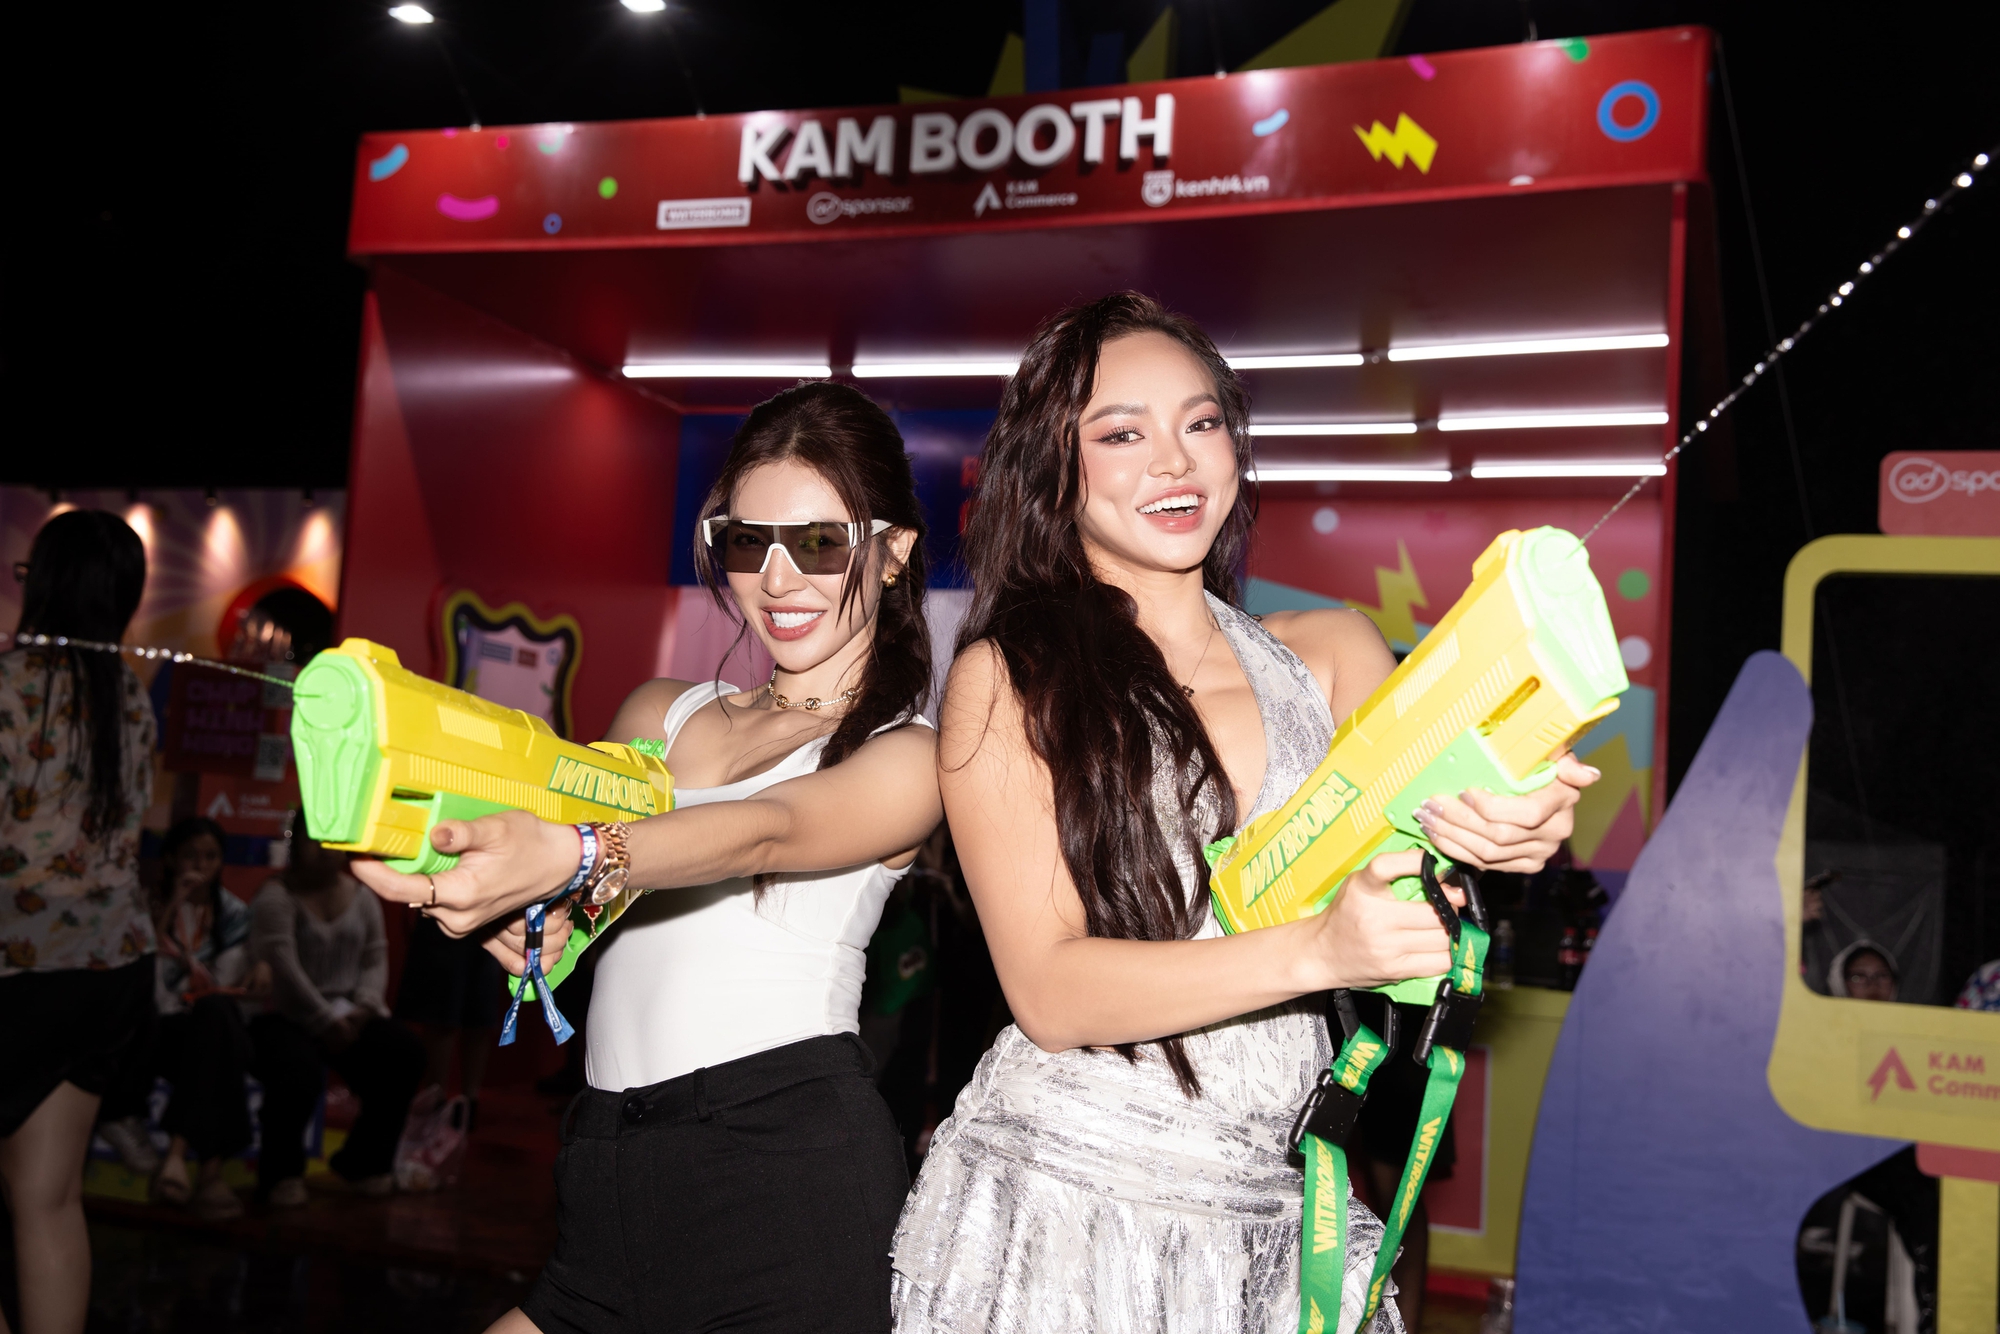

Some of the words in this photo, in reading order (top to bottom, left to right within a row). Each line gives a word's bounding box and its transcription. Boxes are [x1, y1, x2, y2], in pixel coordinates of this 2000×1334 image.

[738, 115, 897, 184] KAM
[909, 93, 1176, 173] BOOTH
[569, 835, 597, 890] SPLASH
[1928, 1050, 1985, 1074] KAM
